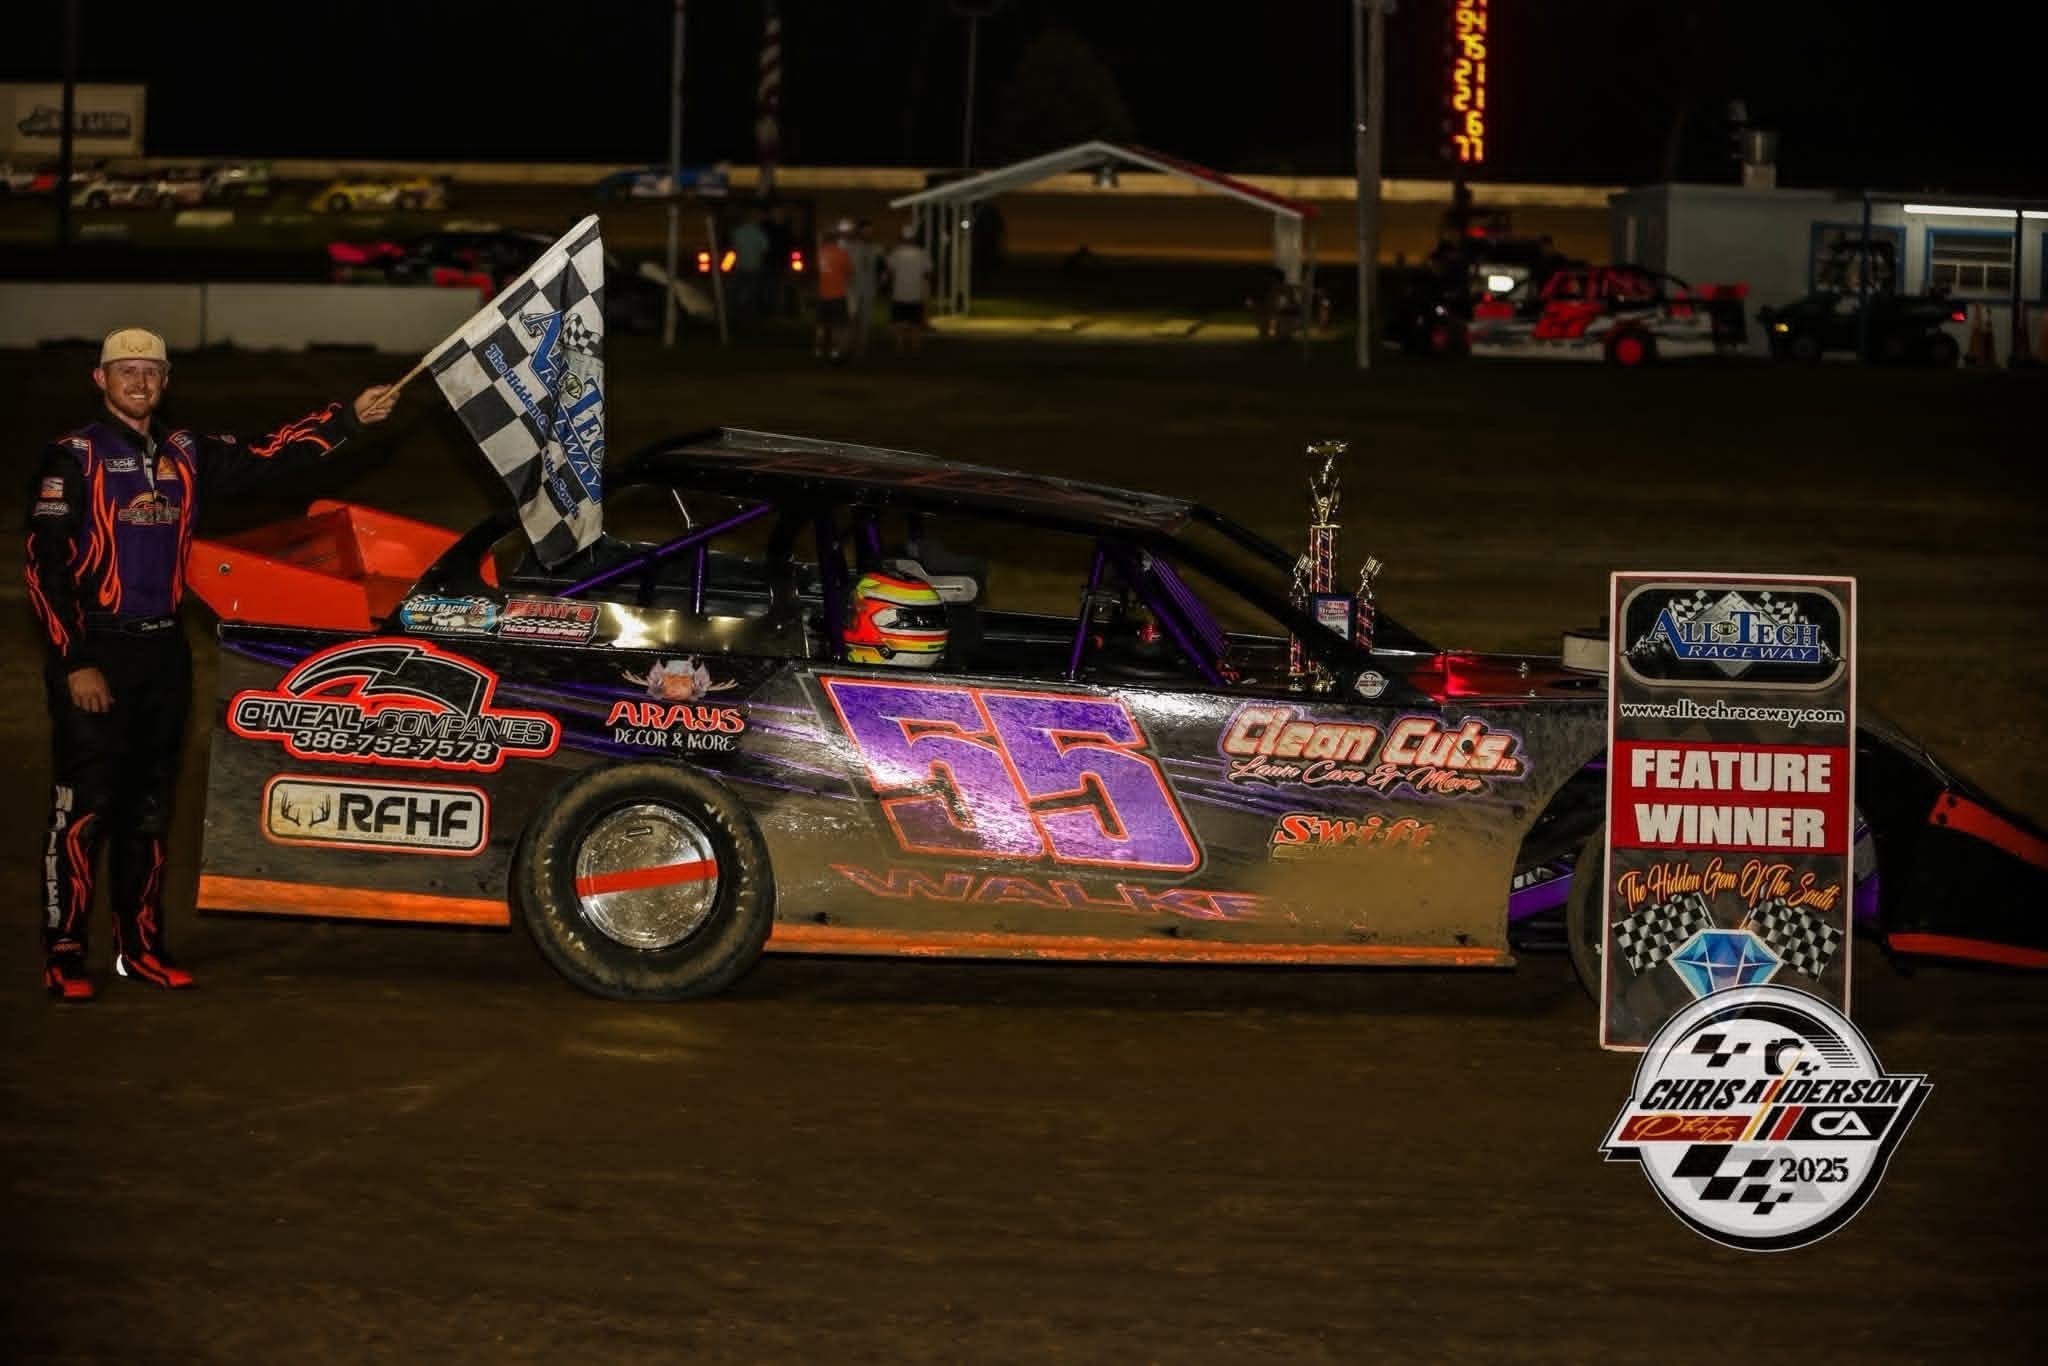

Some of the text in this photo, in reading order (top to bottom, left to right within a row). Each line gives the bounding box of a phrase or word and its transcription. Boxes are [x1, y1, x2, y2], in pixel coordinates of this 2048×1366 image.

[503, 367, 541, 418] Hidden
[404, 601, 435, 613] CRATE
[1687, 646, 1814, 660] RACEWAY
[1223, 706, 1378, 763] Clean
[1620, 699, 1845, 729] www.alltechraceway.com
[293, 730, 492, 760] 386-752-7578
[614, 728, 736, 751] DECOR & MORE
[820, 677, 1200, 872] 55
[1229, 755, 1482, 794] Lawn Care & More
[1631, 748, 1831, 793] FEATURE
[338, 792, 472, 838] RFHF
[1634, 803, 1825, 848] WINNER
[828, 863, 1262, 920] WALKE
[1617, 857, 1841, 912] The Hidden Gem Of The South
